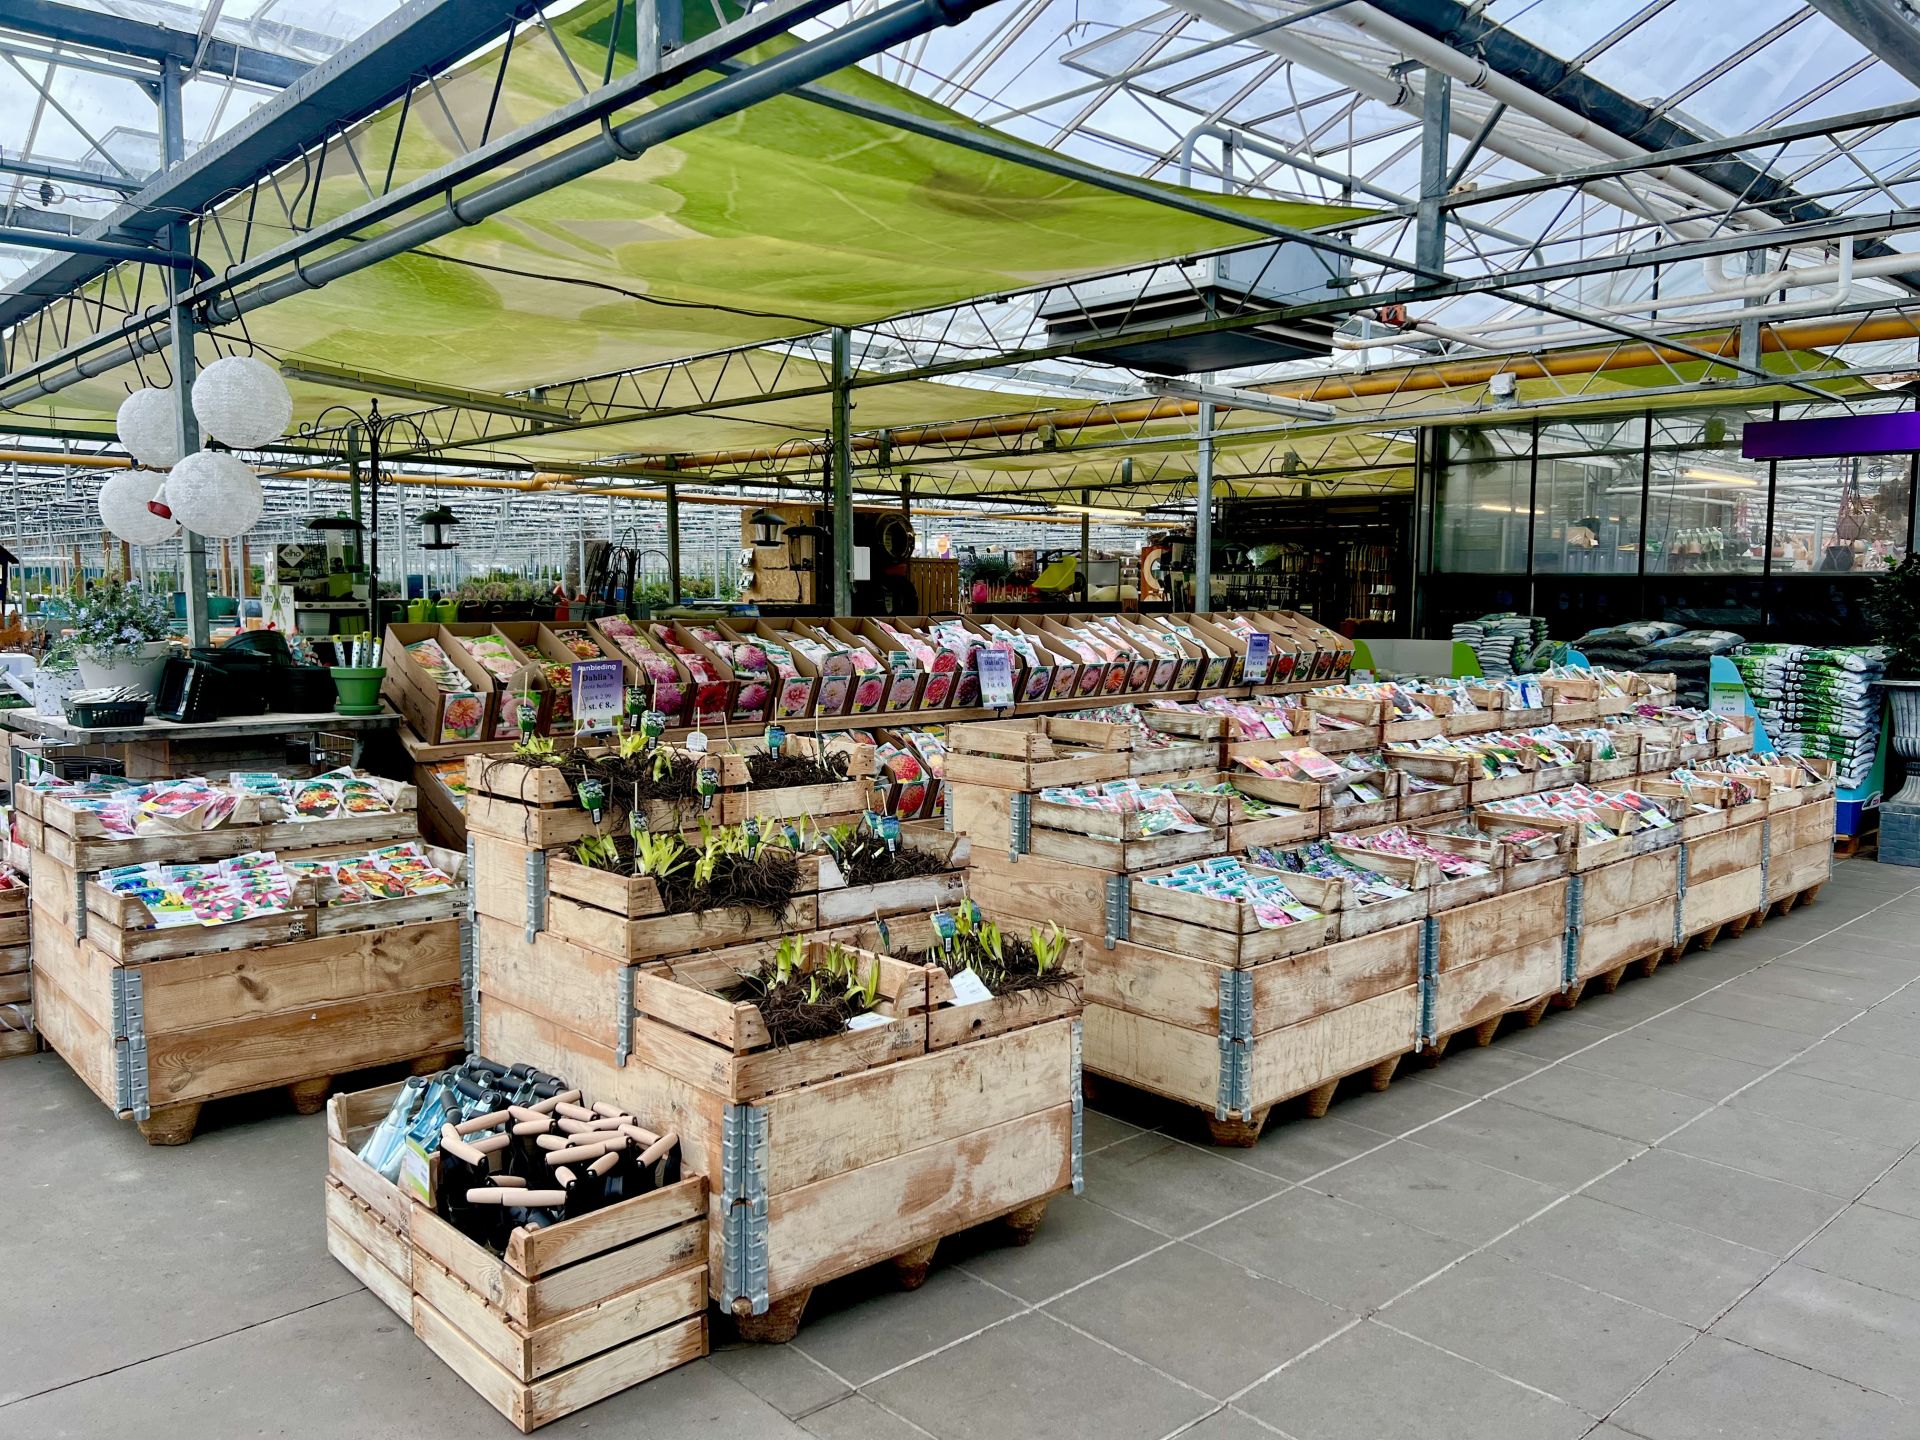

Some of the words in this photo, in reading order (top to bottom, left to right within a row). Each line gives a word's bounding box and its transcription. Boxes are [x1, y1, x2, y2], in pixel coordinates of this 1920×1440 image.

[284, 549, 301, 557] elho
[264, 591, 273, 604] elho
[281, 592, 291, 605] elho
[577, 664, 616, 672] Aanbieding
[582, 673, 614, 681] Dahlia's
